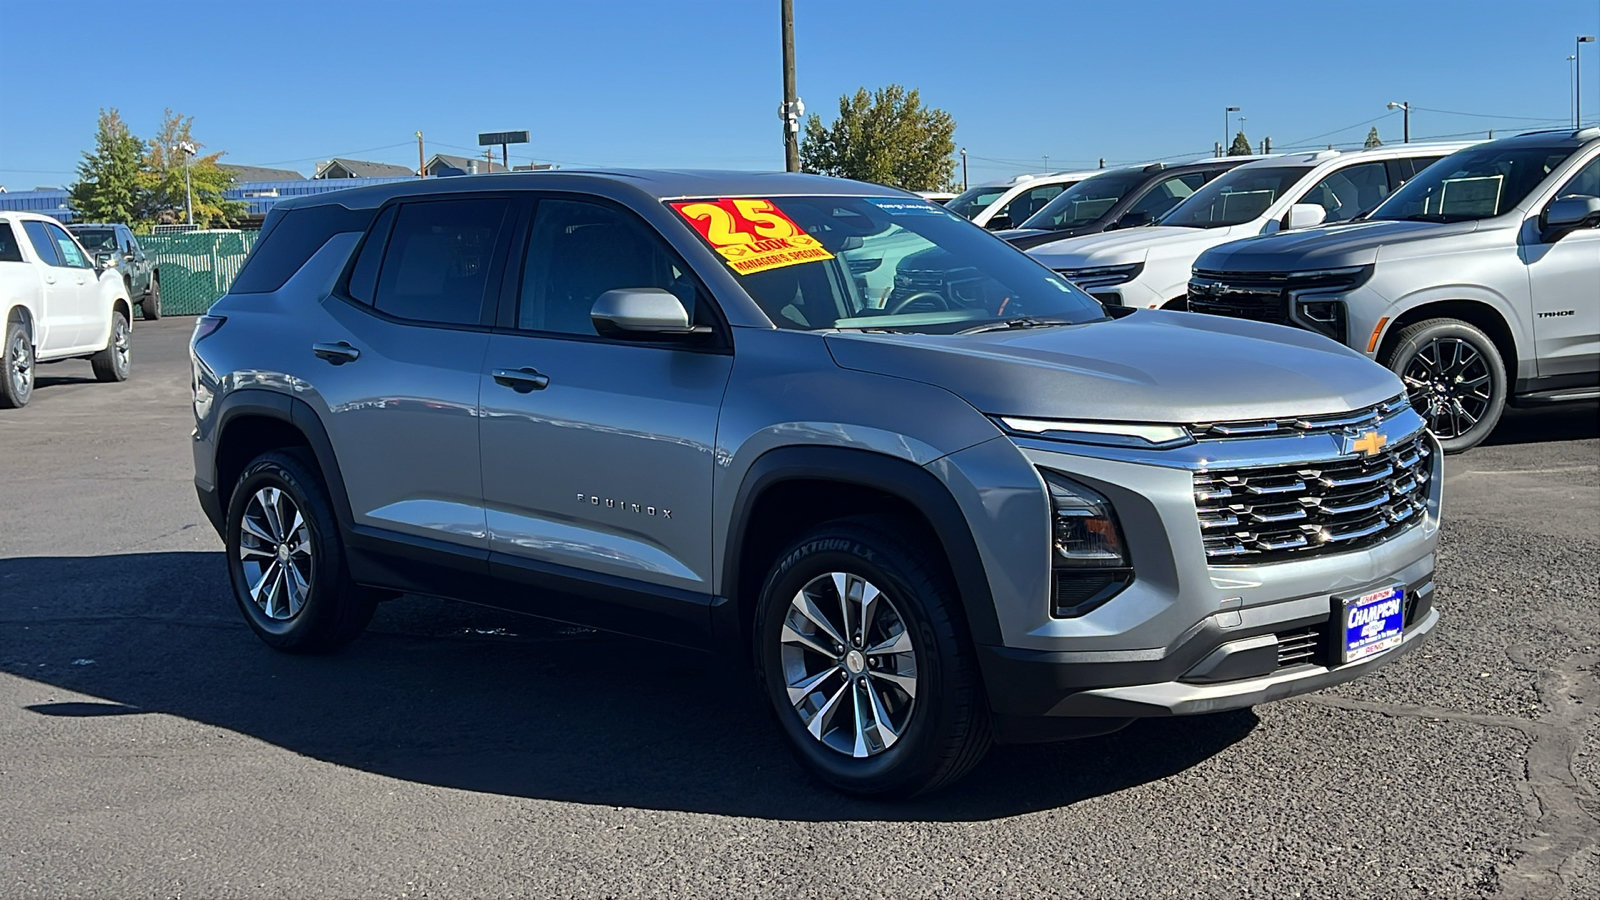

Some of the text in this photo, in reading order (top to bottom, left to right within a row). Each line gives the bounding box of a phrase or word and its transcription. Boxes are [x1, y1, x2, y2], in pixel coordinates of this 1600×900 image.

[681, 200, 799, 246] 25
[745, 238, 793, 254] LOOK
[734, 248, 827, 271] MANAGER'S SPECIAL
[1537, 310, 1575, 318] TAHOE
[577, 494, 672, 519] EQUINOX
[781, 539, 875, 574] MAXTOUR LX
[1348, 599, 1400, 629] CHAMPION
